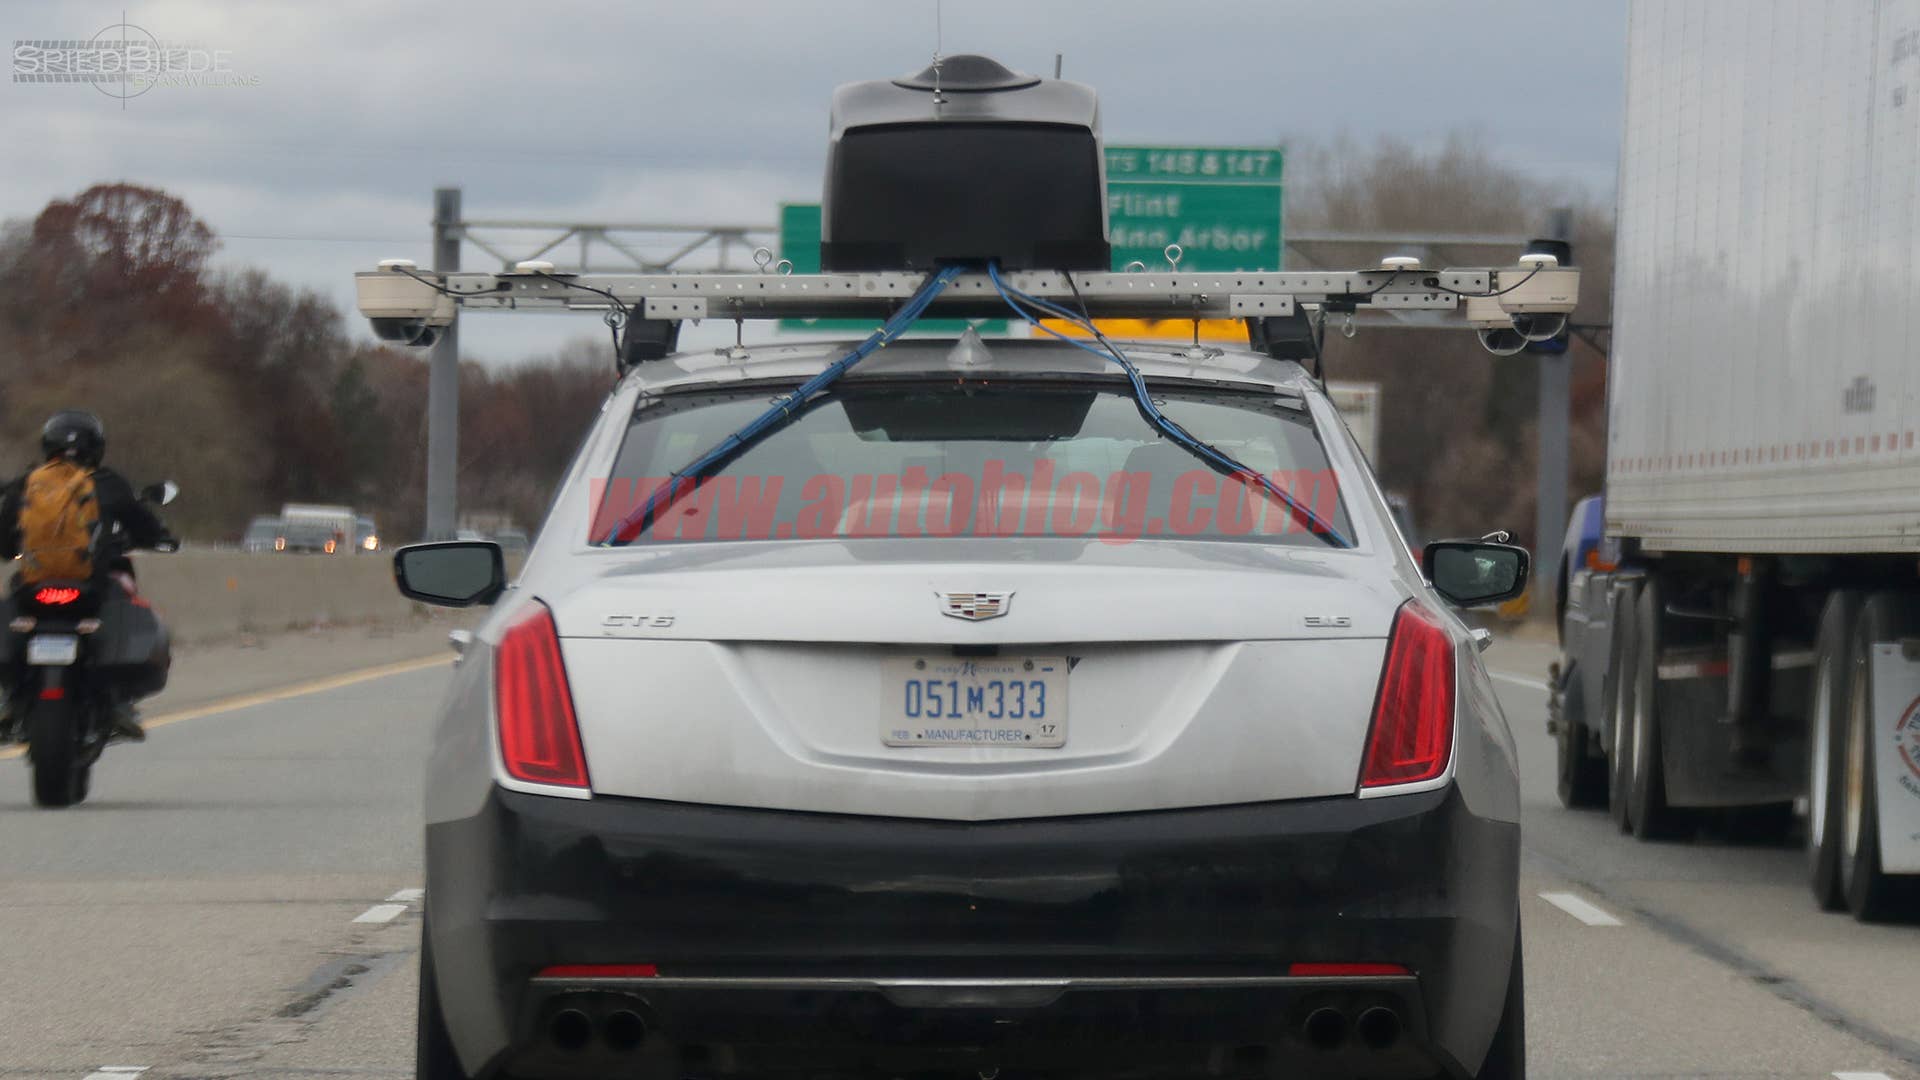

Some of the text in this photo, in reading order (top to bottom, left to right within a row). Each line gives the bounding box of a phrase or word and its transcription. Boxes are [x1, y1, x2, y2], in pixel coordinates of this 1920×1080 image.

[1226, 154, 1270, 175] 147
[1109, 193, 1180, 217] Flint
[1111, 227, 1266, 249] Ann Arbor
[601, 615, 675, 628] CT6
[905, 679, 1046, 719] 051M333
[924, 729, 1023, 741] MANUFACTURER
[1041, 724, 1056, 733] 17
